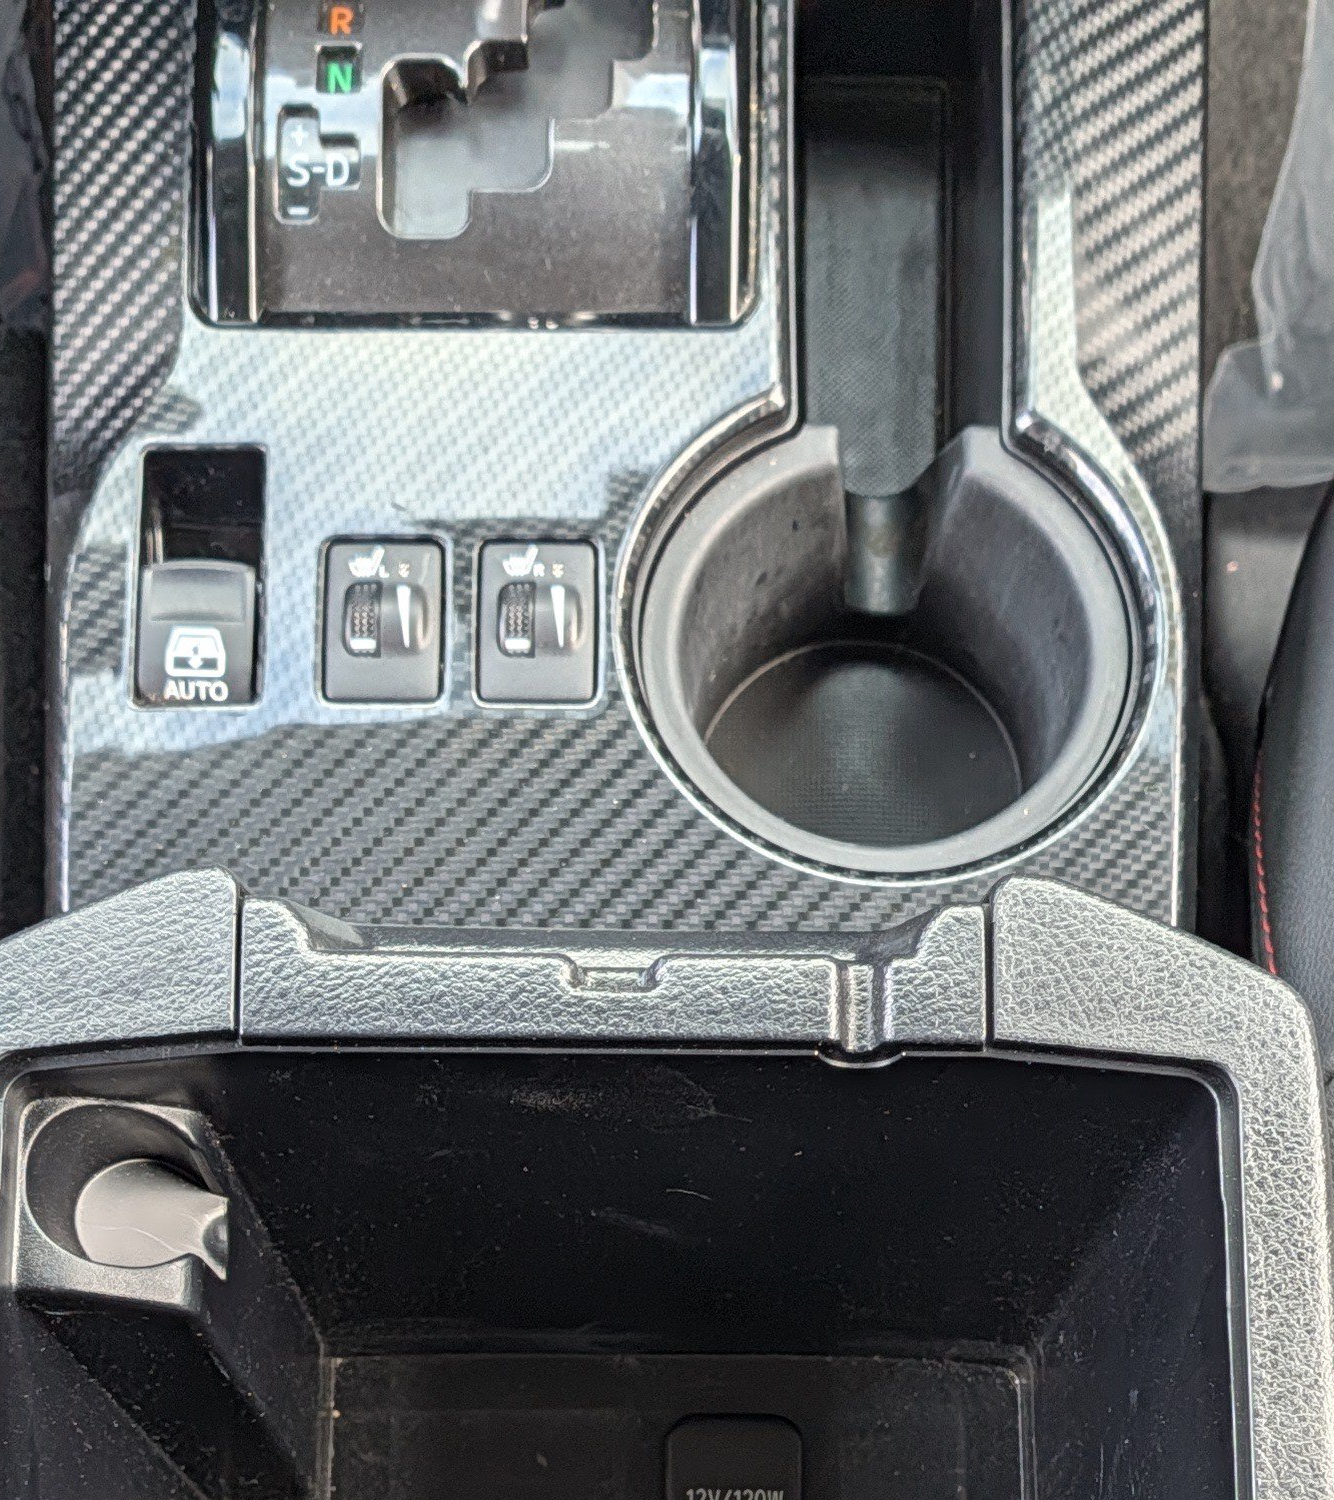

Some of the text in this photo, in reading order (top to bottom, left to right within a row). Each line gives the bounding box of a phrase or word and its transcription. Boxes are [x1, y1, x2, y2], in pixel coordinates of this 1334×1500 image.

[330, 6, 354, 35] R
[327, 62, 353, 94] N
[163, 679, 229, 702] AUTO
